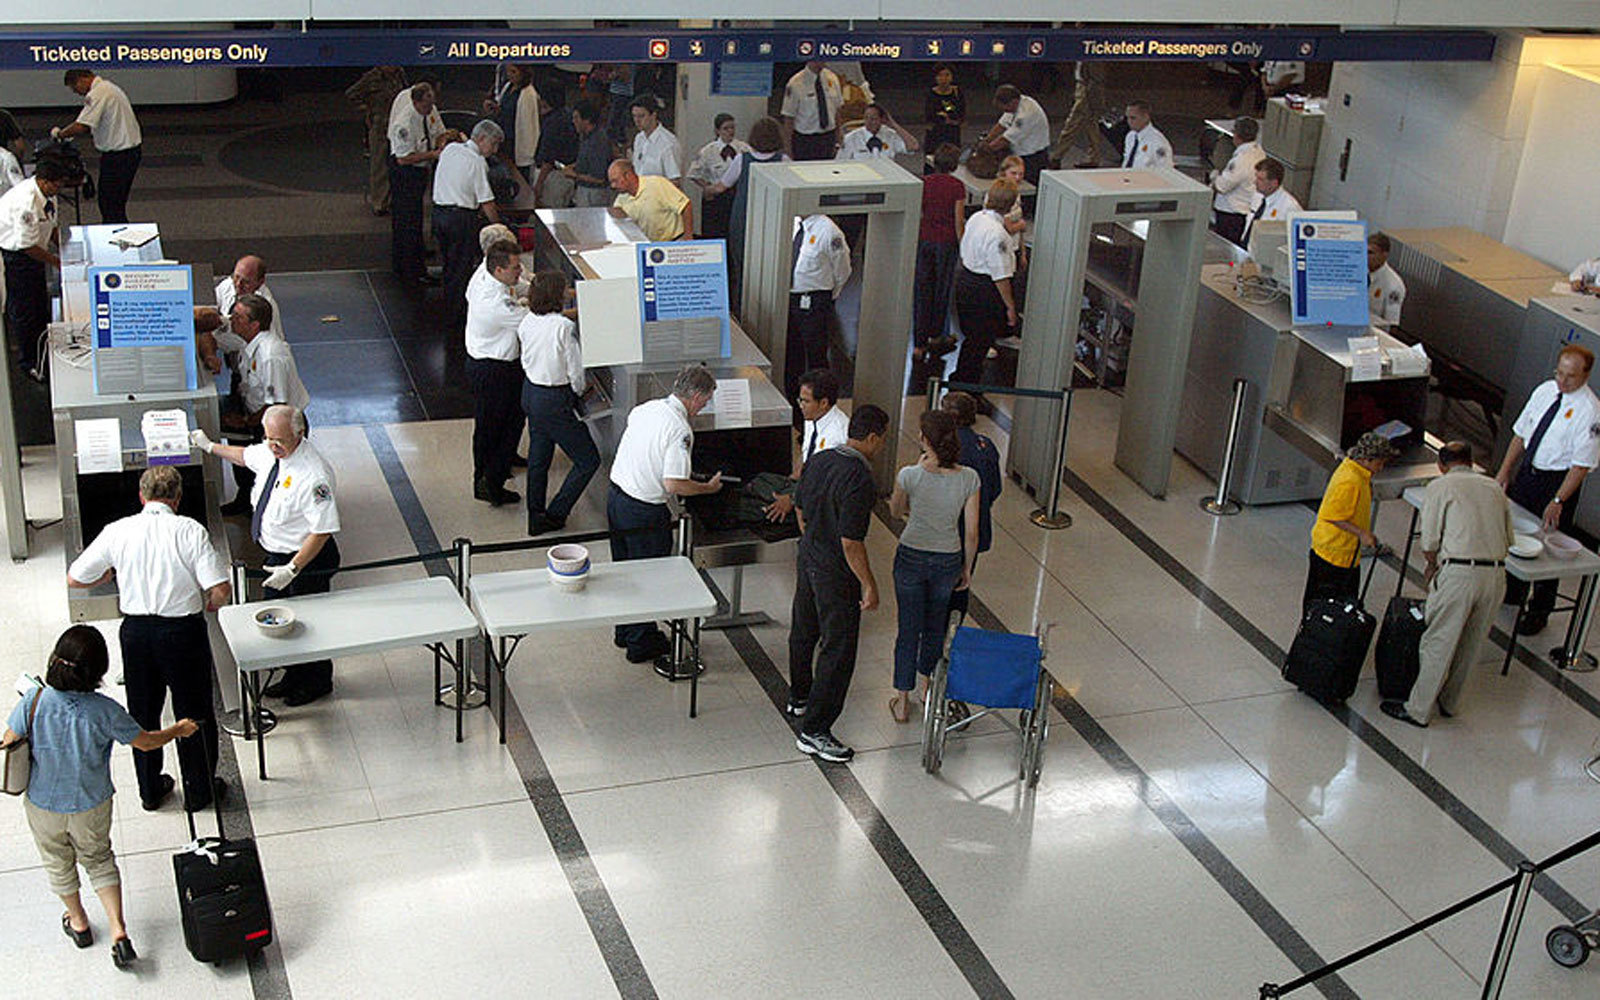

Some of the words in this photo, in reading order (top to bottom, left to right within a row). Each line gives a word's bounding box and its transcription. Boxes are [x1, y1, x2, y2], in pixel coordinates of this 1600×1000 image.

[30, 45, 111, 62] Ticketed
[117, 44, 222, 63] Passengers
[227, 43, 268, 62] Only
[448, 42, 470, 57] All
[475, 42, 571, 59] Departures
[819, 43, 839, 55] No
[841, 42, 901, 58] Smoking
[1082, 40, 1144, 55] Ticketed
[1147, 40, 1228, 57] Passengers
[1231, 41, 1263, 57] Only
